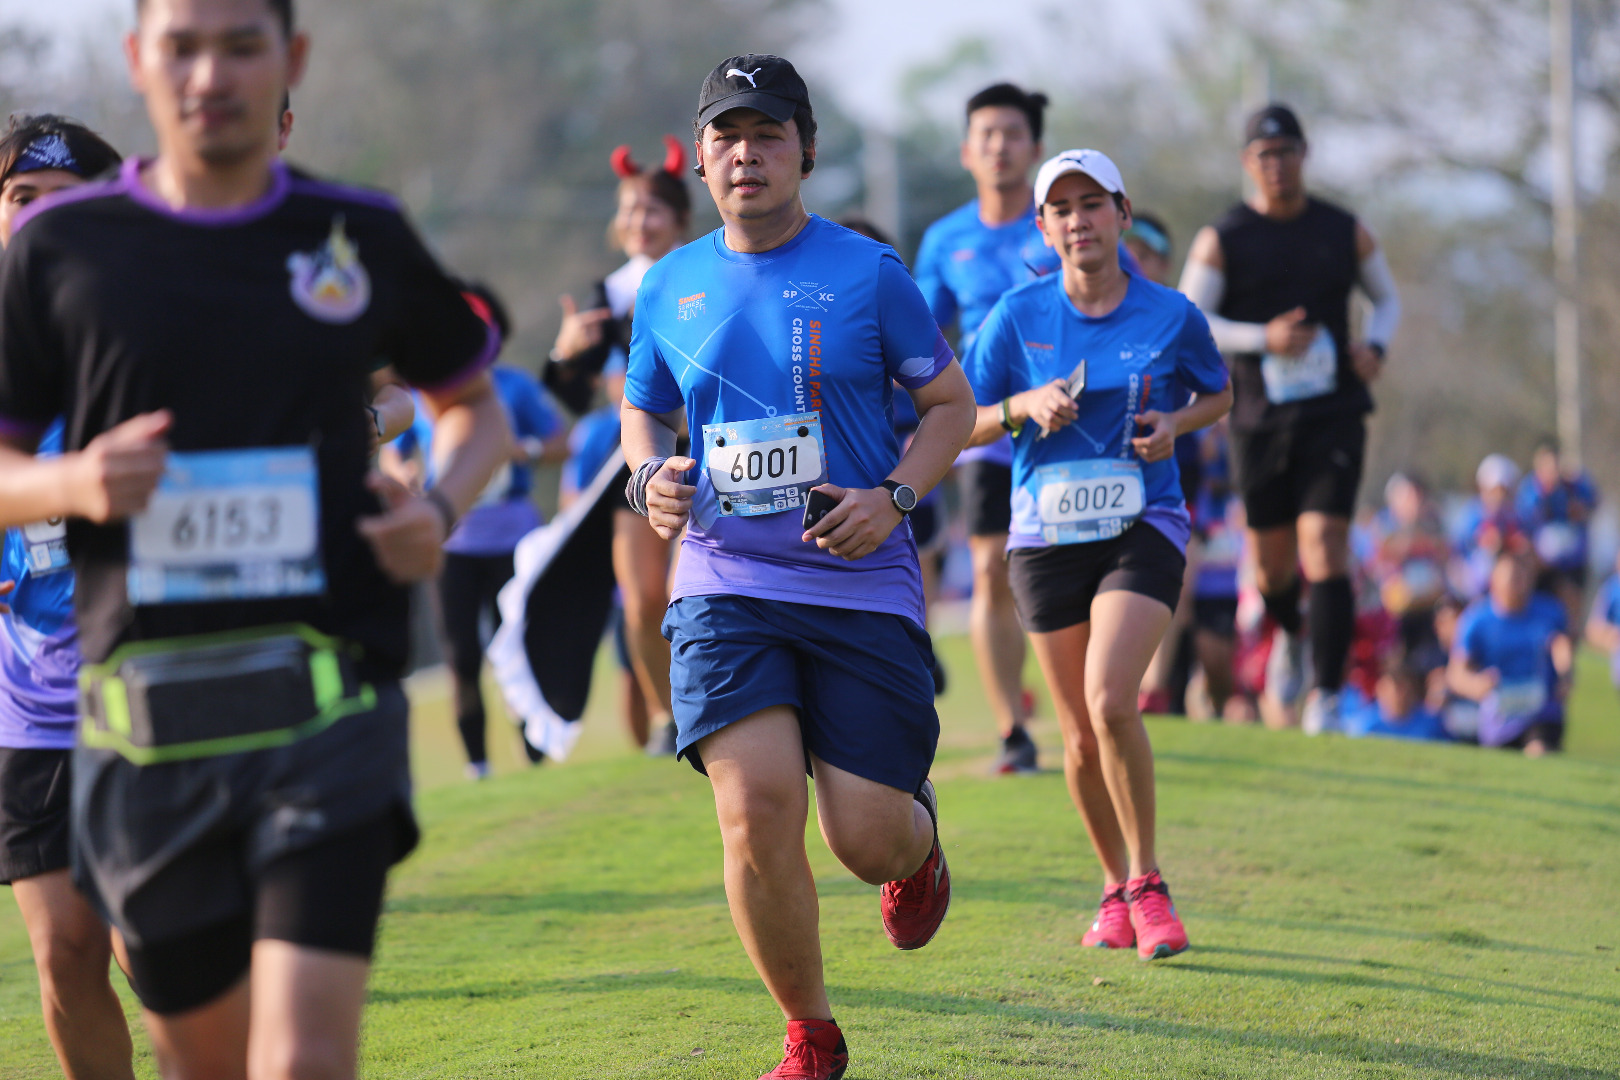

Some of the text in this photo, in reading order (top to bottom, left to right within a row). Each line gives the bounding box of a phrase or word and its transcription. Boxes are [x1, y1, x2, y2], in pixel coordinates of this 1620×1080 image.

[678, 292, 706, 304] SINGHA
[783, 290, 834, 302] SP XC
[792, 318, 806, 412] CROSS COUNT
[809, 320, 822, 377] SINGHA
[1127, 373, 1139, 410] CROSS
[730, 446, 797, 482] 6001
[1058, 484, 1125, 514] 6002
[172, 497, 282, 550] 6153
